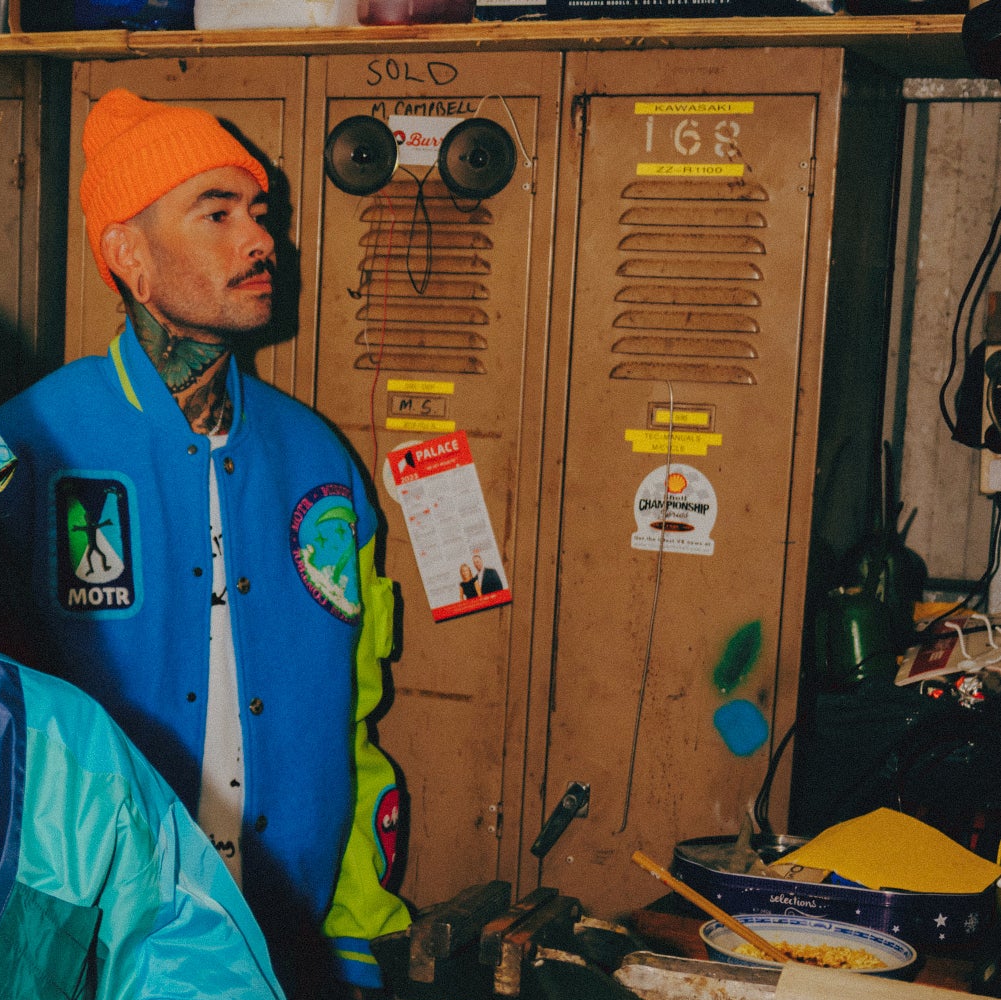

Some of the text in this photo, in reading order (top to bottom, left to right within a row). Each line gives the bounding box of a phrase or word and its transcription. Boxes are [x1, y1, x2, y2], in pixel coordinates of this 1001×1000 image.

[366, 57, 458, 86] SOLD
[394, 101, 479, 117] CAMPBELL
[654, 103, 732, 113] KAWASAKI
[406, 132, 445, 148] Bur
[645, 115, 741, 158] 168
[415, 439, 459, 462] PALACE
[67, 586, 131, 607] MOTR
